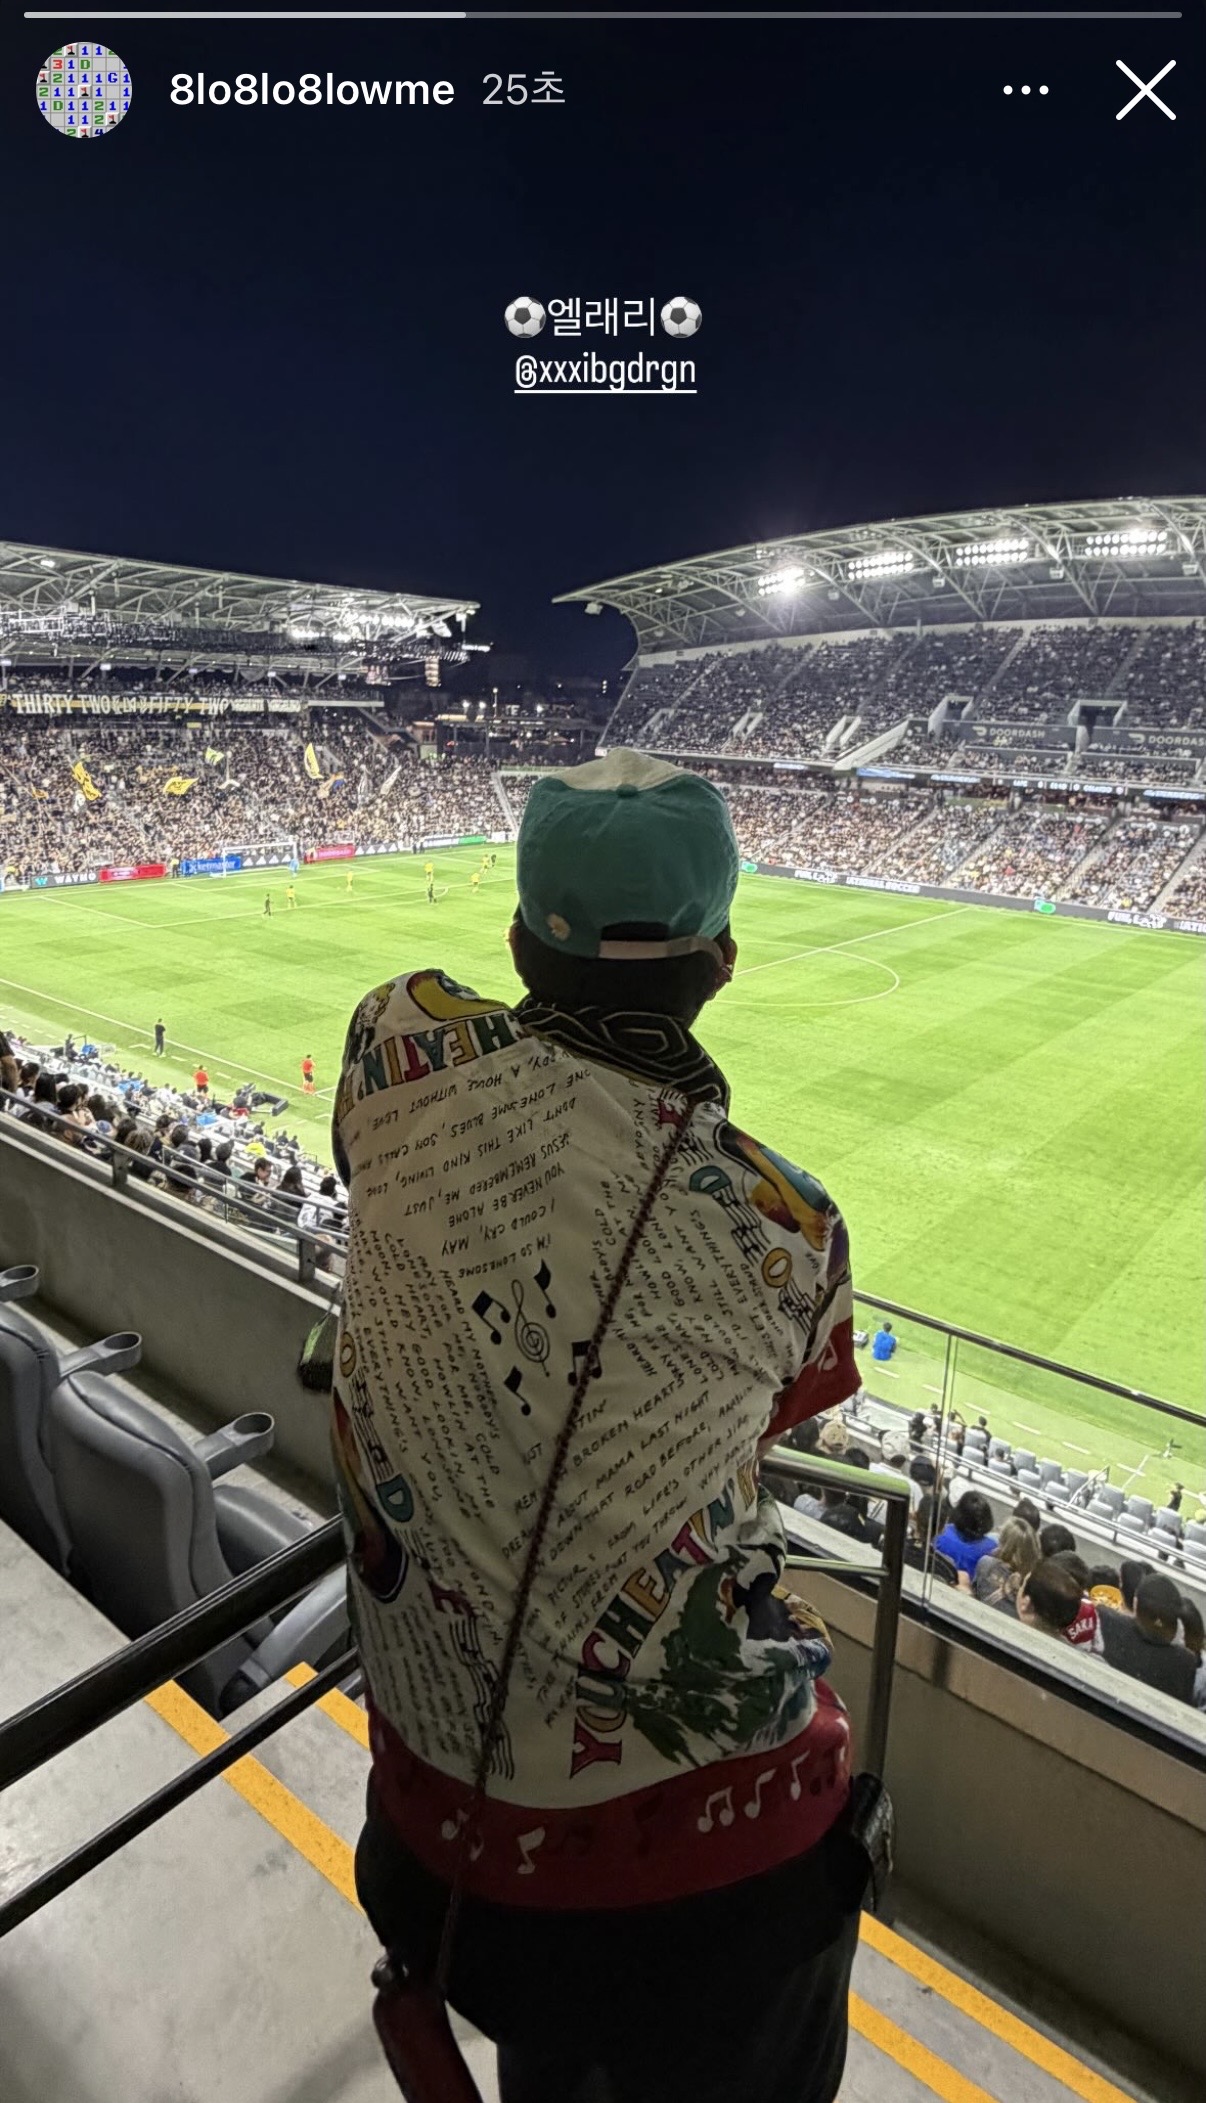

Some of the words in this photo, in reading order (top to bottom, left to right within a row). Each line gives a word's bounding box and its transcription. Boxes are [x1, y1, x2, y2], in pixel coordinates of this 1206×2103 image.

[11, 692, 74, 715] THIRTY
[77, 693, 111, 714] TWO
[149, 693, 193, 714] FIFTY
[989, 727, 1046, 738] DOORDASH
[54, 872, 97, 885] WAYMO
[357, 1010, 518, 1100] HEATIN'
[510, 1066, 520, 1078] A
[408, 1084, 458, 1114] WITHOUT
[542, 1096, 576, 1122] DON'T
[478, 1136, 502, 1156] THIS
[506, 1118, 534, 1144] LIKE
[540, 1130, 570, 1160] JESUS
[442, 1150, 470, 1172] KIND
[468, 1152, 536, 1196] REMEMBERED
[544, 1162, 566, 1184] YOU
[404, 1196, 434, 1216] JUST
[492, 1194, 508, 1212] BE
[508, 1176, 544, 1204] NEVER
[600, 1180, 616, 1210] THE
[510, 1204, 546, 1230] COULD
[594, 1208, 616, 1246] COLD
[614, 1218, 628, 1236] AT
[442, 1236, 470, 1256] MAY
[674, 1226, 706, 1270] WANT
[690, 1208, 748, 1304] EVERYTHING'S
[660, 1270, 686, 1308] GOOD
[710, 1280, 732, 1316] STILL
[370, 1230, 392, 1276] MOON,
[394, 1294, 416, 1332] HEY
[412, 1342, 434, 1390] GOOD
[372, 1266, 398, 1328] WOULD
[396, 1342, 422, 1402] KNOW,
[438, 1270, 466, 1314] HEARD
[462, 1320, 476, 1342] MY
[472, 1348, 498, 1410] MOTHER
[384, 1232, 406, 1272] COLD
[404, 1284, 432, 1340] HEART,
[464, 1442, 480, 1464] AT
[476, 1474, 496, 1508] THE
[396, 1238, 444, 1328] LONESOME
[442, 1342, 460, 1374] FOR
[474, 1432, 500, 1476] COLD
[626, 1342, 658, 1376] HEARD
[700, 1350, 724, 1382] COLD
[363, 1327, 408, 1453] EVERYTHING'S
[374, 1316, 394, 1368] STILL
[394, 1380, 422, 1438] WANT
[468, 1372, 500, 1440] NOBODY'S
[572, 1420, 630, 1468] BROKEN
[596, 1450, 636, 1490] MAMA
[640, 1420, 670, 1450] LAST
[674, 1390, 710, 1424] NIGHT
[550, 1522, 584, 1562] DOWN
[624, 1464, 656, 1498] ROAD
[658, 1422, 712, 1468] BEFORE,
[642, 1478, 680, 1516] LIFE'S
